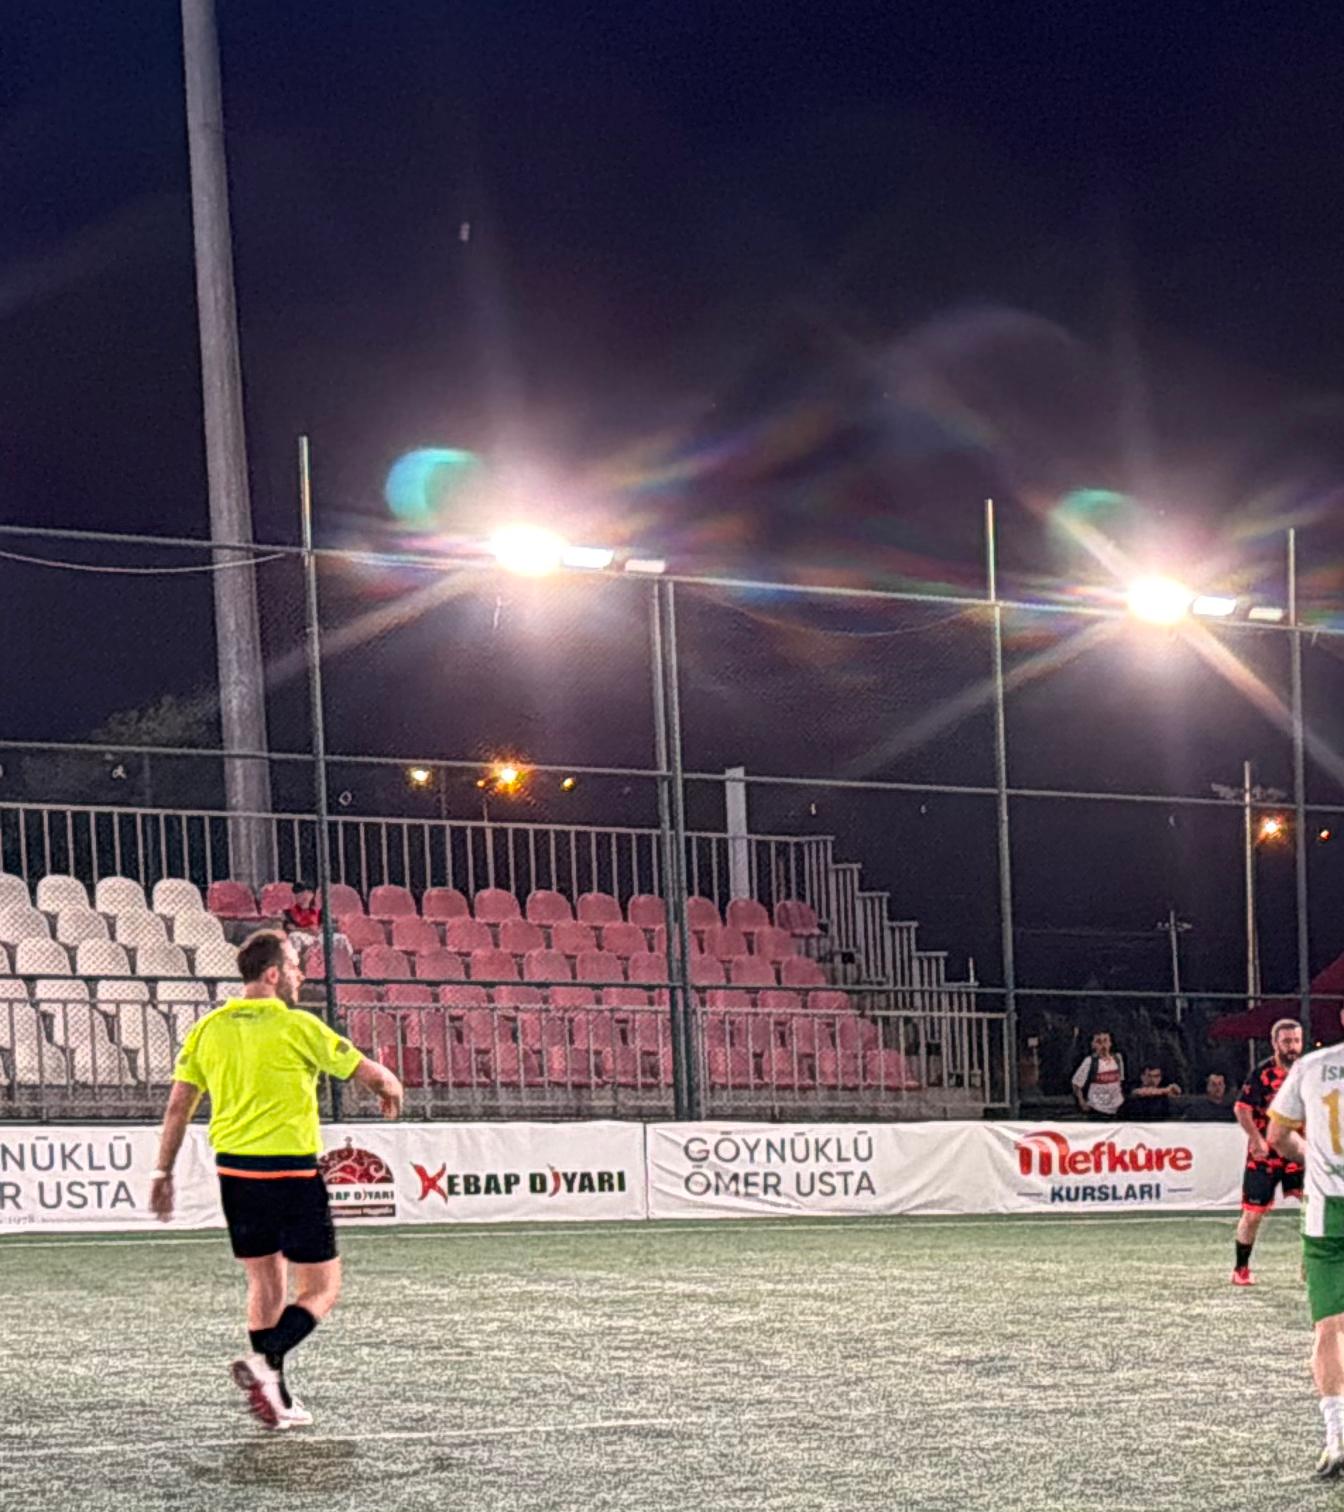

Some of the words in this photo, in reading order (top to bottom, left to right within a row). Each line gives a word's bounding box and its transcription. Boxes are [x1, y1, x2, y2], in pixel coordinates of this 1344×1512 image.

[683, 1130, 874, 1164] GÖYNÜKLÜ
[38, 1180, 136, 1209] USTA
[409, 1161, 520, 1205] KEBAP
[684, 1164, 782, 1197] ÖMER
[795, 1171, 877, 1198] USTA
[1051, 1183, 1161, 1204] KURSLARI
